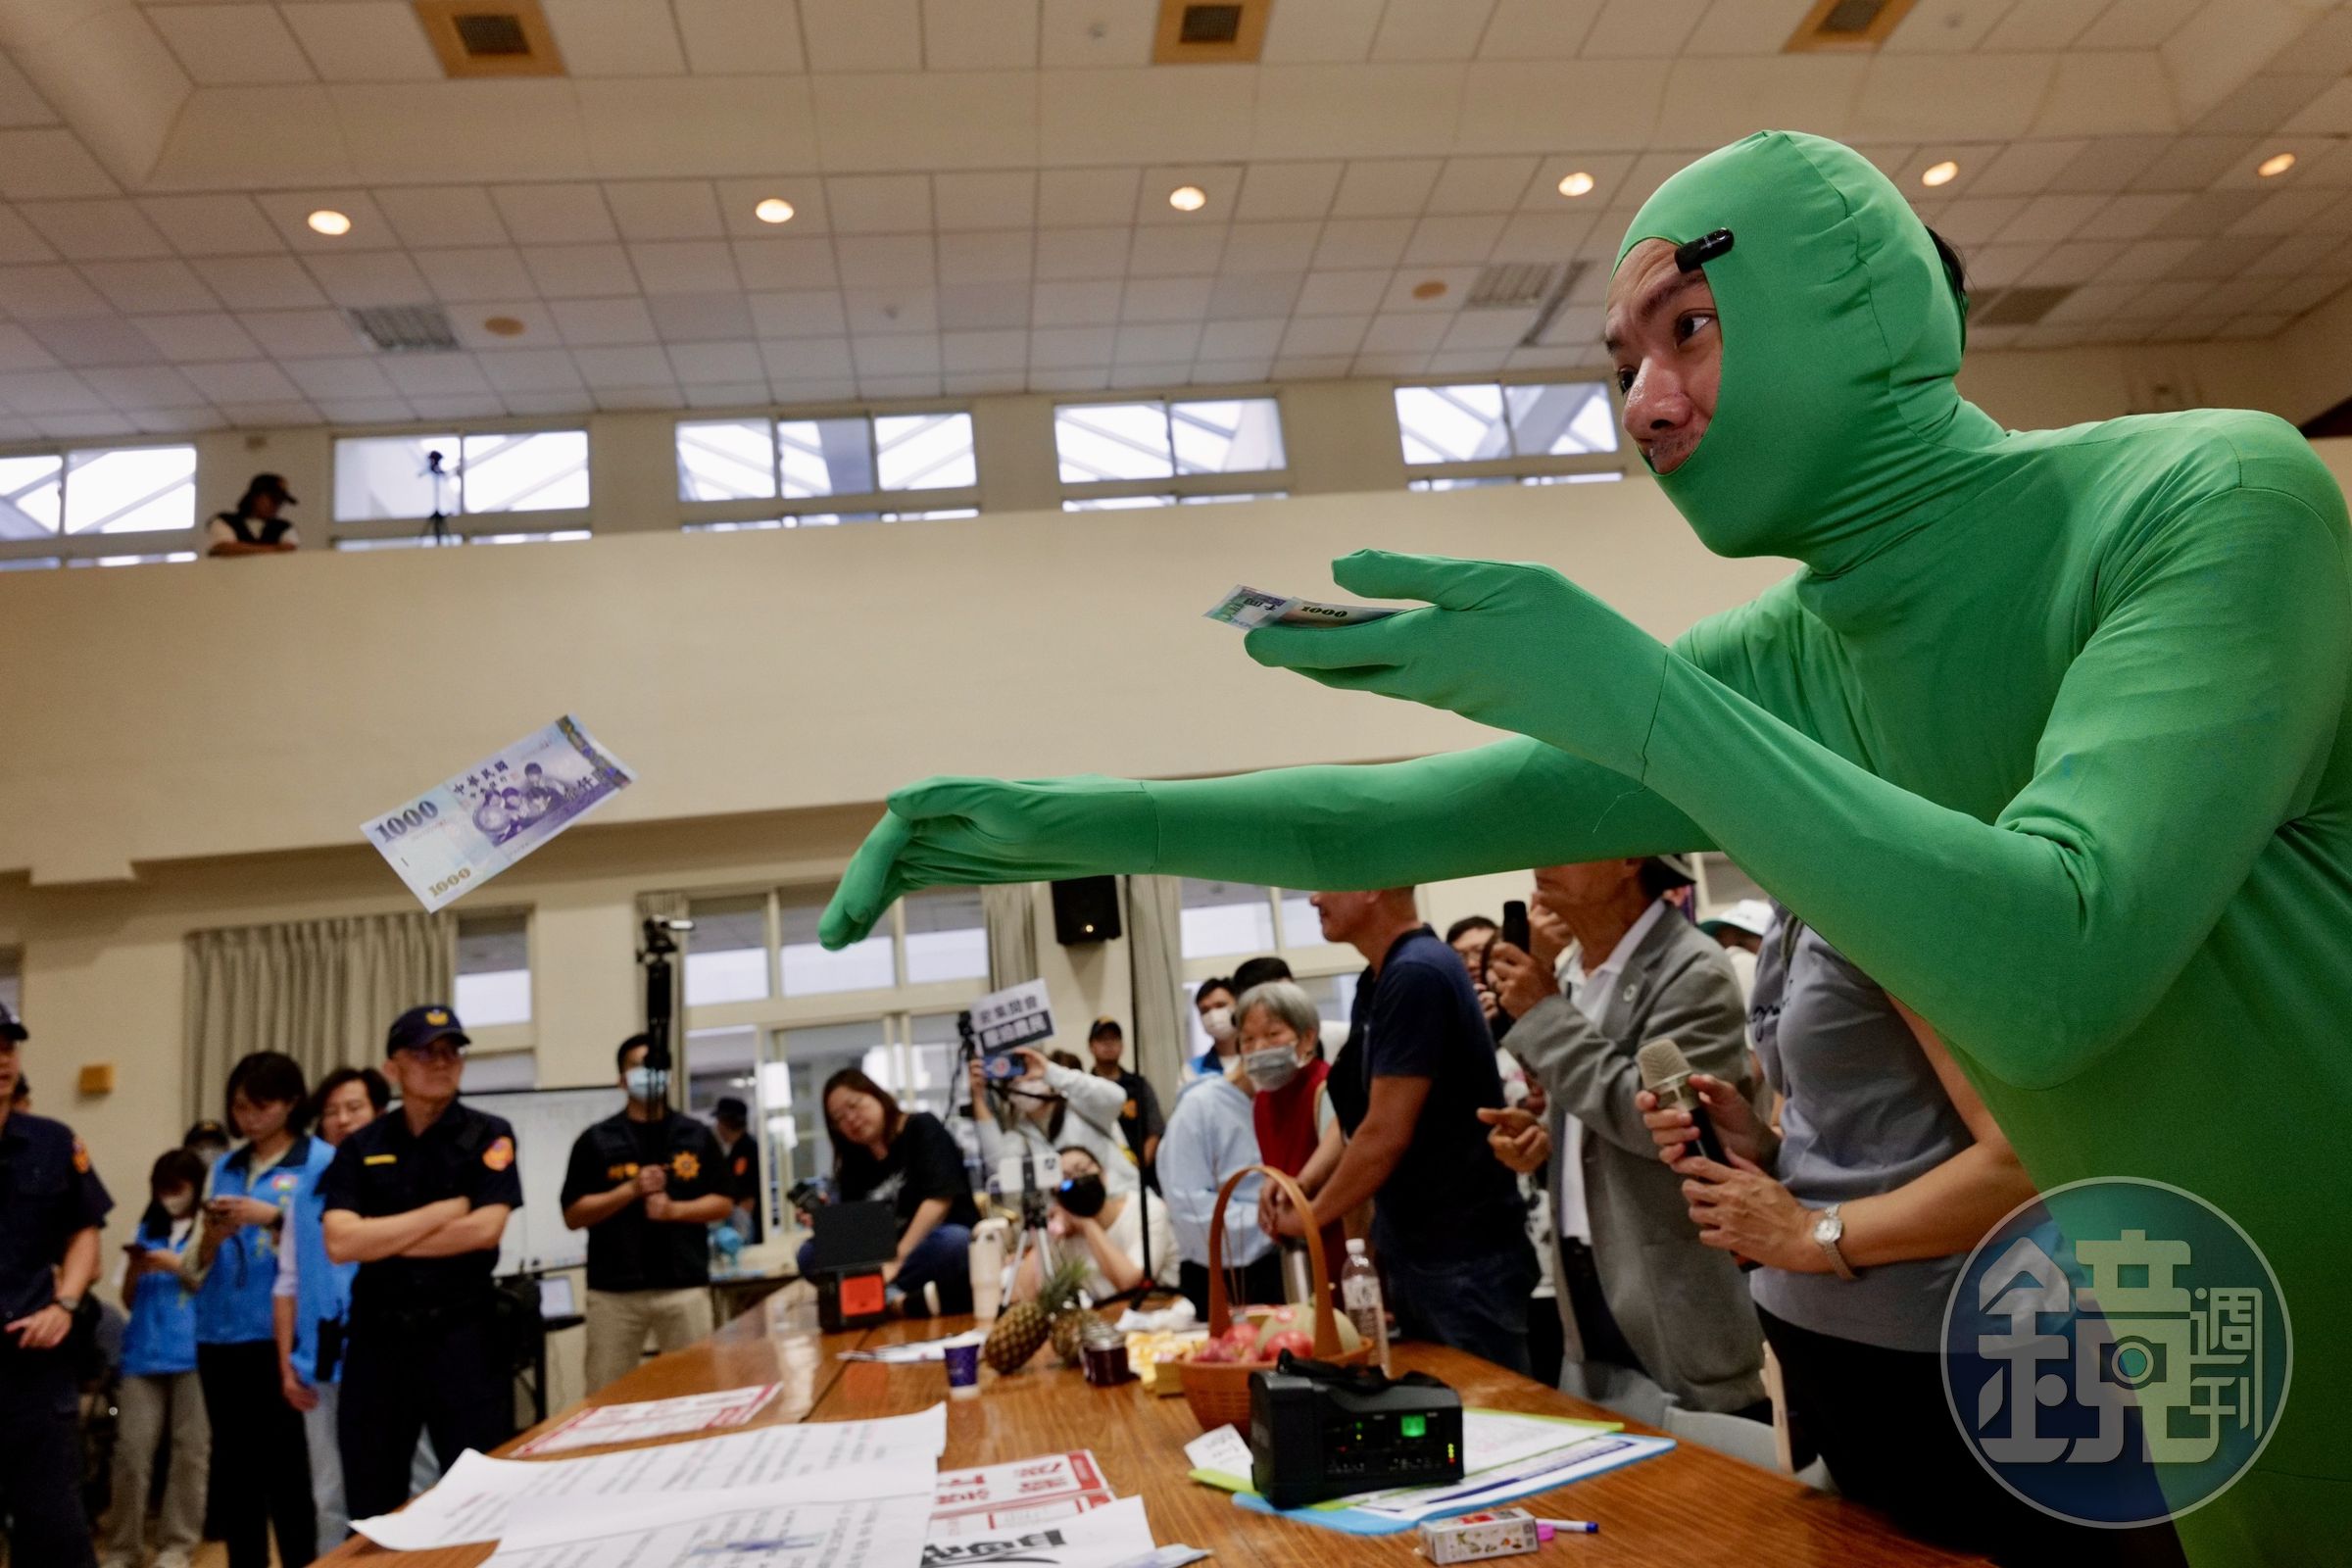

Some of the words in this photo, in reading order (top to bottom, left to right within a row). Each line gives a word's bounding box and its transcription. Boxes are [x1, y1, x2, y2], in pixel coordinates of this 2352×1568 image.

[1300, 605, 1348, 618] 1000
[453, 760, 509, 795] 中華民國
[374, 800, 439, 844] 1000
[427, 866, 471, 899] 1000
